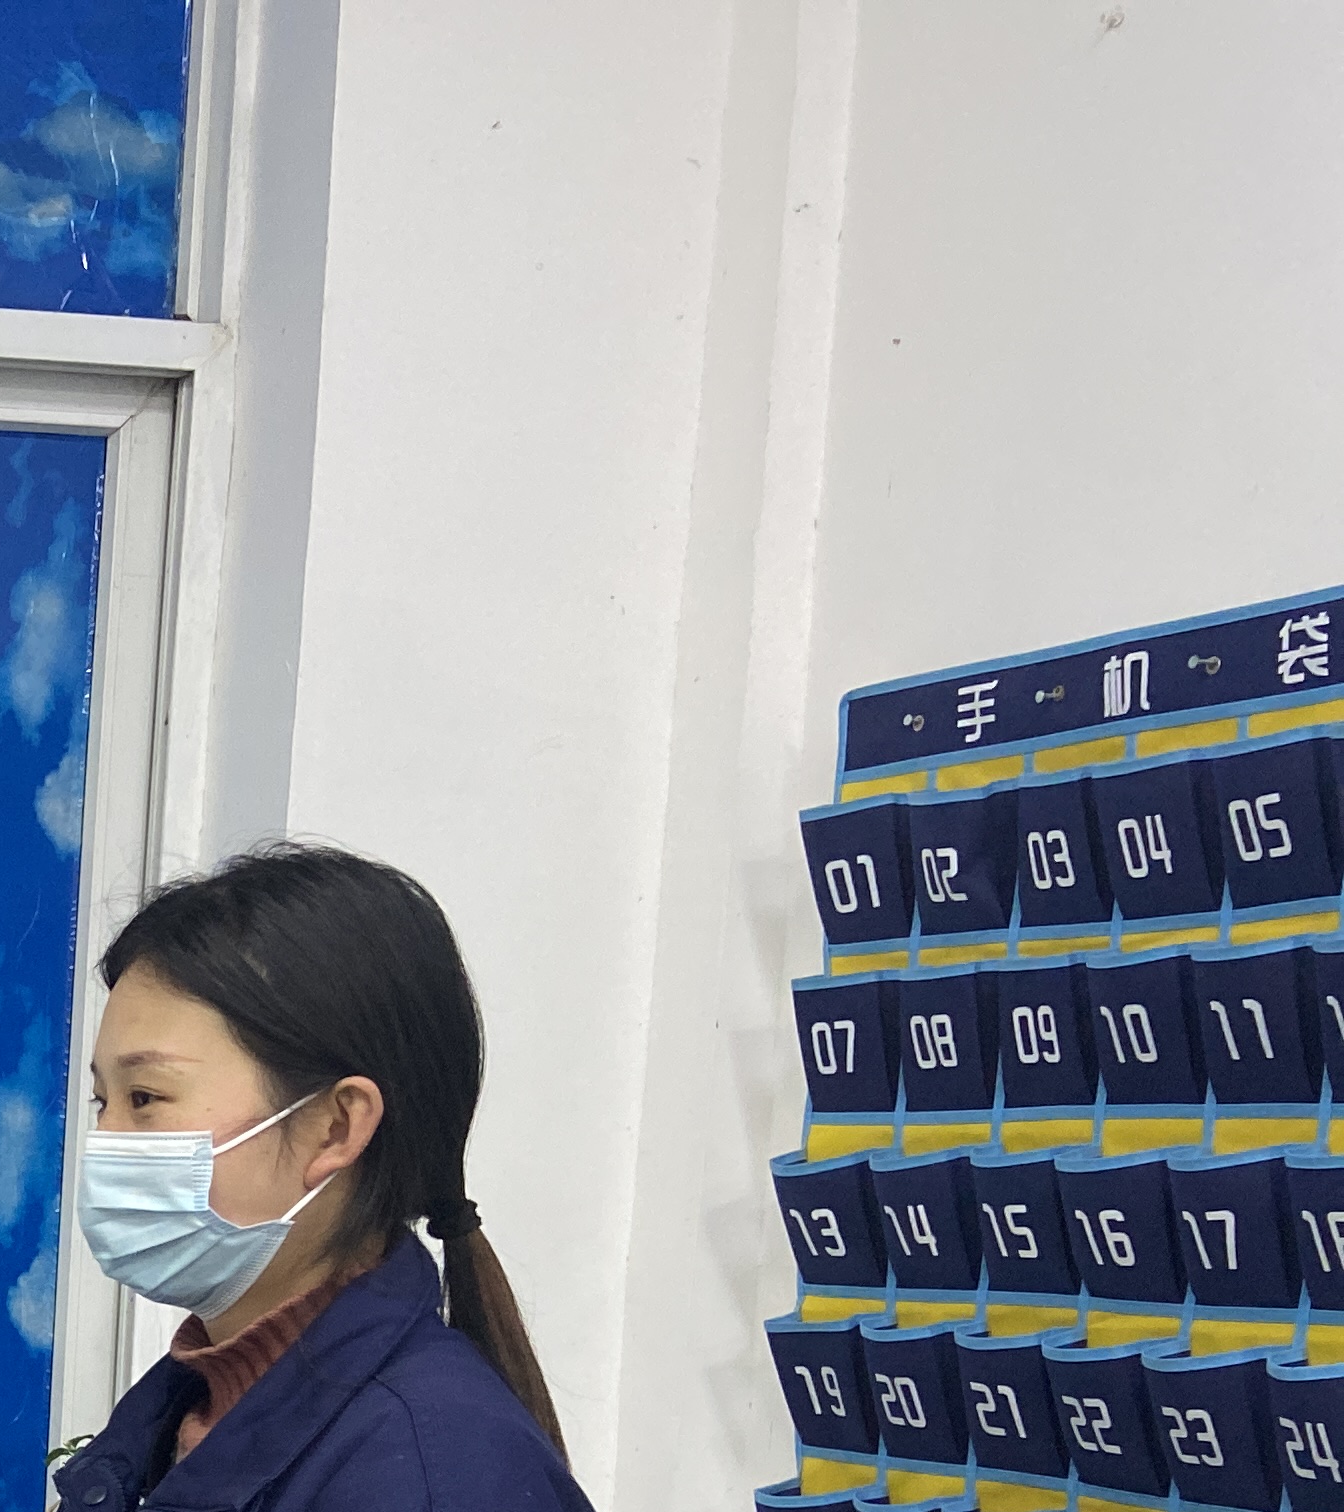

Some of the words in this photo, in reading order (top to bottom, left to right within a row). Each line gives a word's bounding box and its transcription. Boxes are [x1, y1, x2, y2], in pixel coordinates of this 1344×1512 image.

[825, 855, 880, 913] 01
[922, 848, 968, 902] 02
[1028, 830, 1074, 889] 03
[1118, 814, 1172, 878] 04
[1229, 793, 1291, 861] 05
[812, 1020, 855, 1074] 07
[910, 1014, 957, 1068] 08
[1013, 1006, 1060, 1063] 09
[1100, 1004, 1157, 1063] 10
[1210, 999, 1273, 1059] 11
[788, 1209, 845, 1259] 13
[884, 1205, 938, 1256] 14
[982, 1204, 1038, 1258] 15
[1075, 1210, 1135, 1266] 16
[1182, 1210, 1237, 1269] 17
[795, 1366, 845, 1416] 19
[875, 1374, 926, 1427] 20
[970, 1382, 1026, 1438] 21
[1062, 1396, 1121, 1454] 22
[1162, 1407, 1223, 1466] 23
[1280, 1417, 1341, 1482] 24
